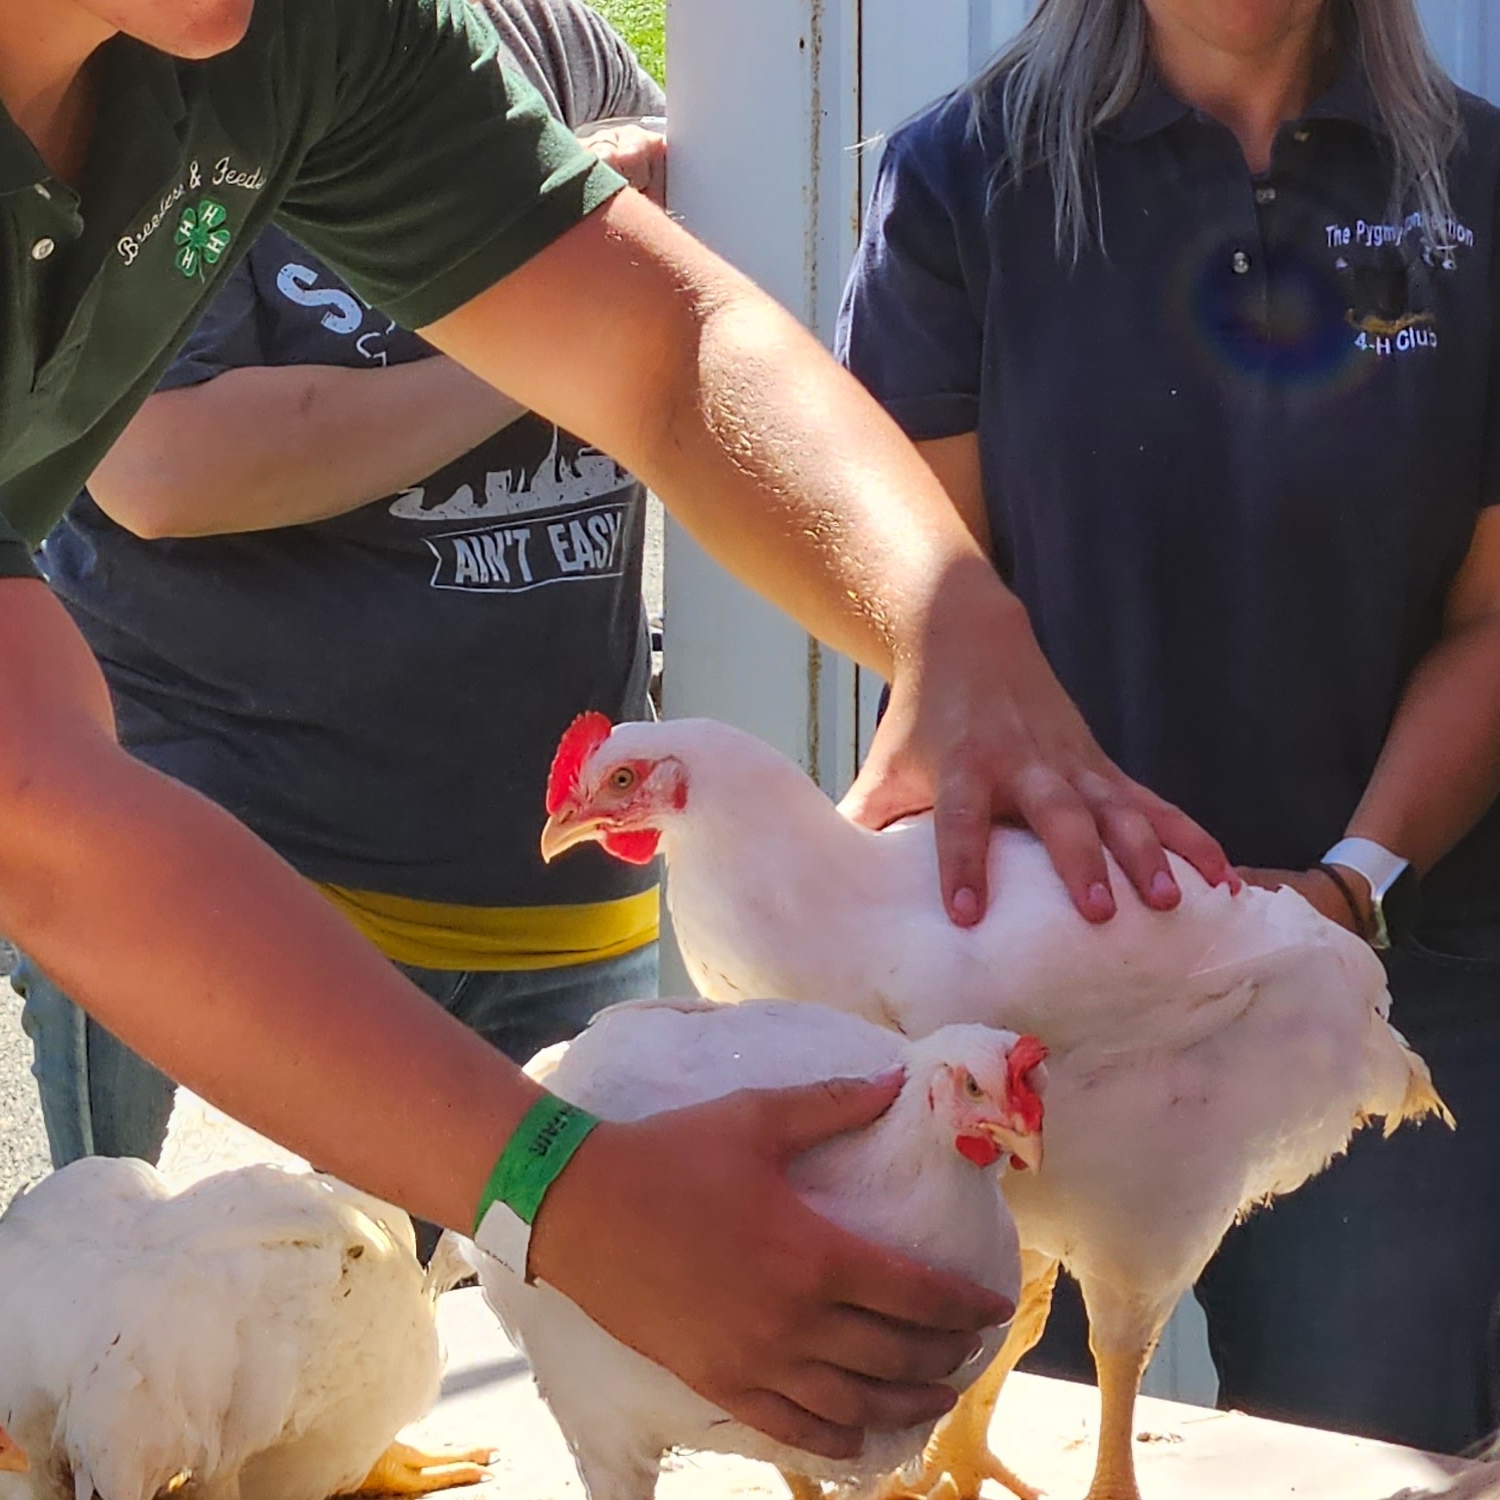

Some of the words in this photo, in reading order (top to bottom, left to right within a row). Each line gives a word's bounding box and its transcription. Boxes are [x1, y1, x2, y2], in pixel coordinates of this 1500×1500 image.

[189, 160, 201, 189] &
[1326, 224, 1351, 248] The
[1357, 219, 1404, 247] Pygmy
[1354, 332, 1392, 356] 4-H
[453, 528, 533, 584] AIN'T
[548, 512, 622, 573] EASY
